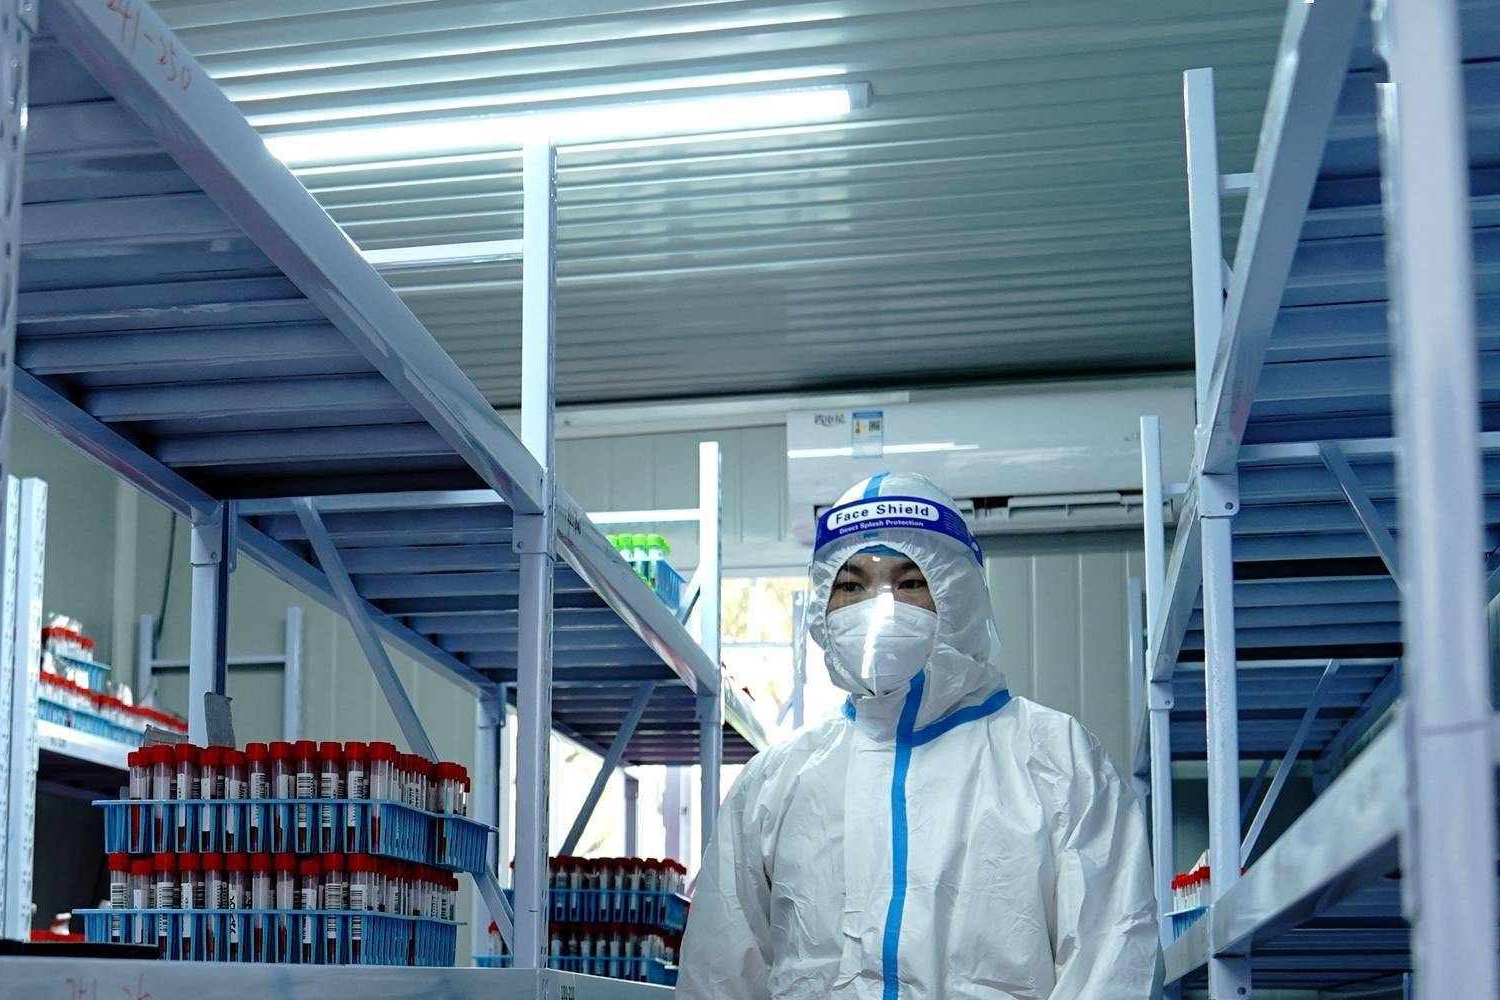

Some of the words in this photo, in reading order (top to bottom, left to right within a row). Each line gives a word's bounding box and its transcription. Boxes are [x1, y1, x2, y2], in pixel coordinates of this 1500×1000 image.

[835, 509, 869, 524] Face
[876, 504, 930, 517] Shield
[839, 524, 859, 534] Direct
[860, 520, 884, 530] Splash
[885, 519, 924, 527] Protection
